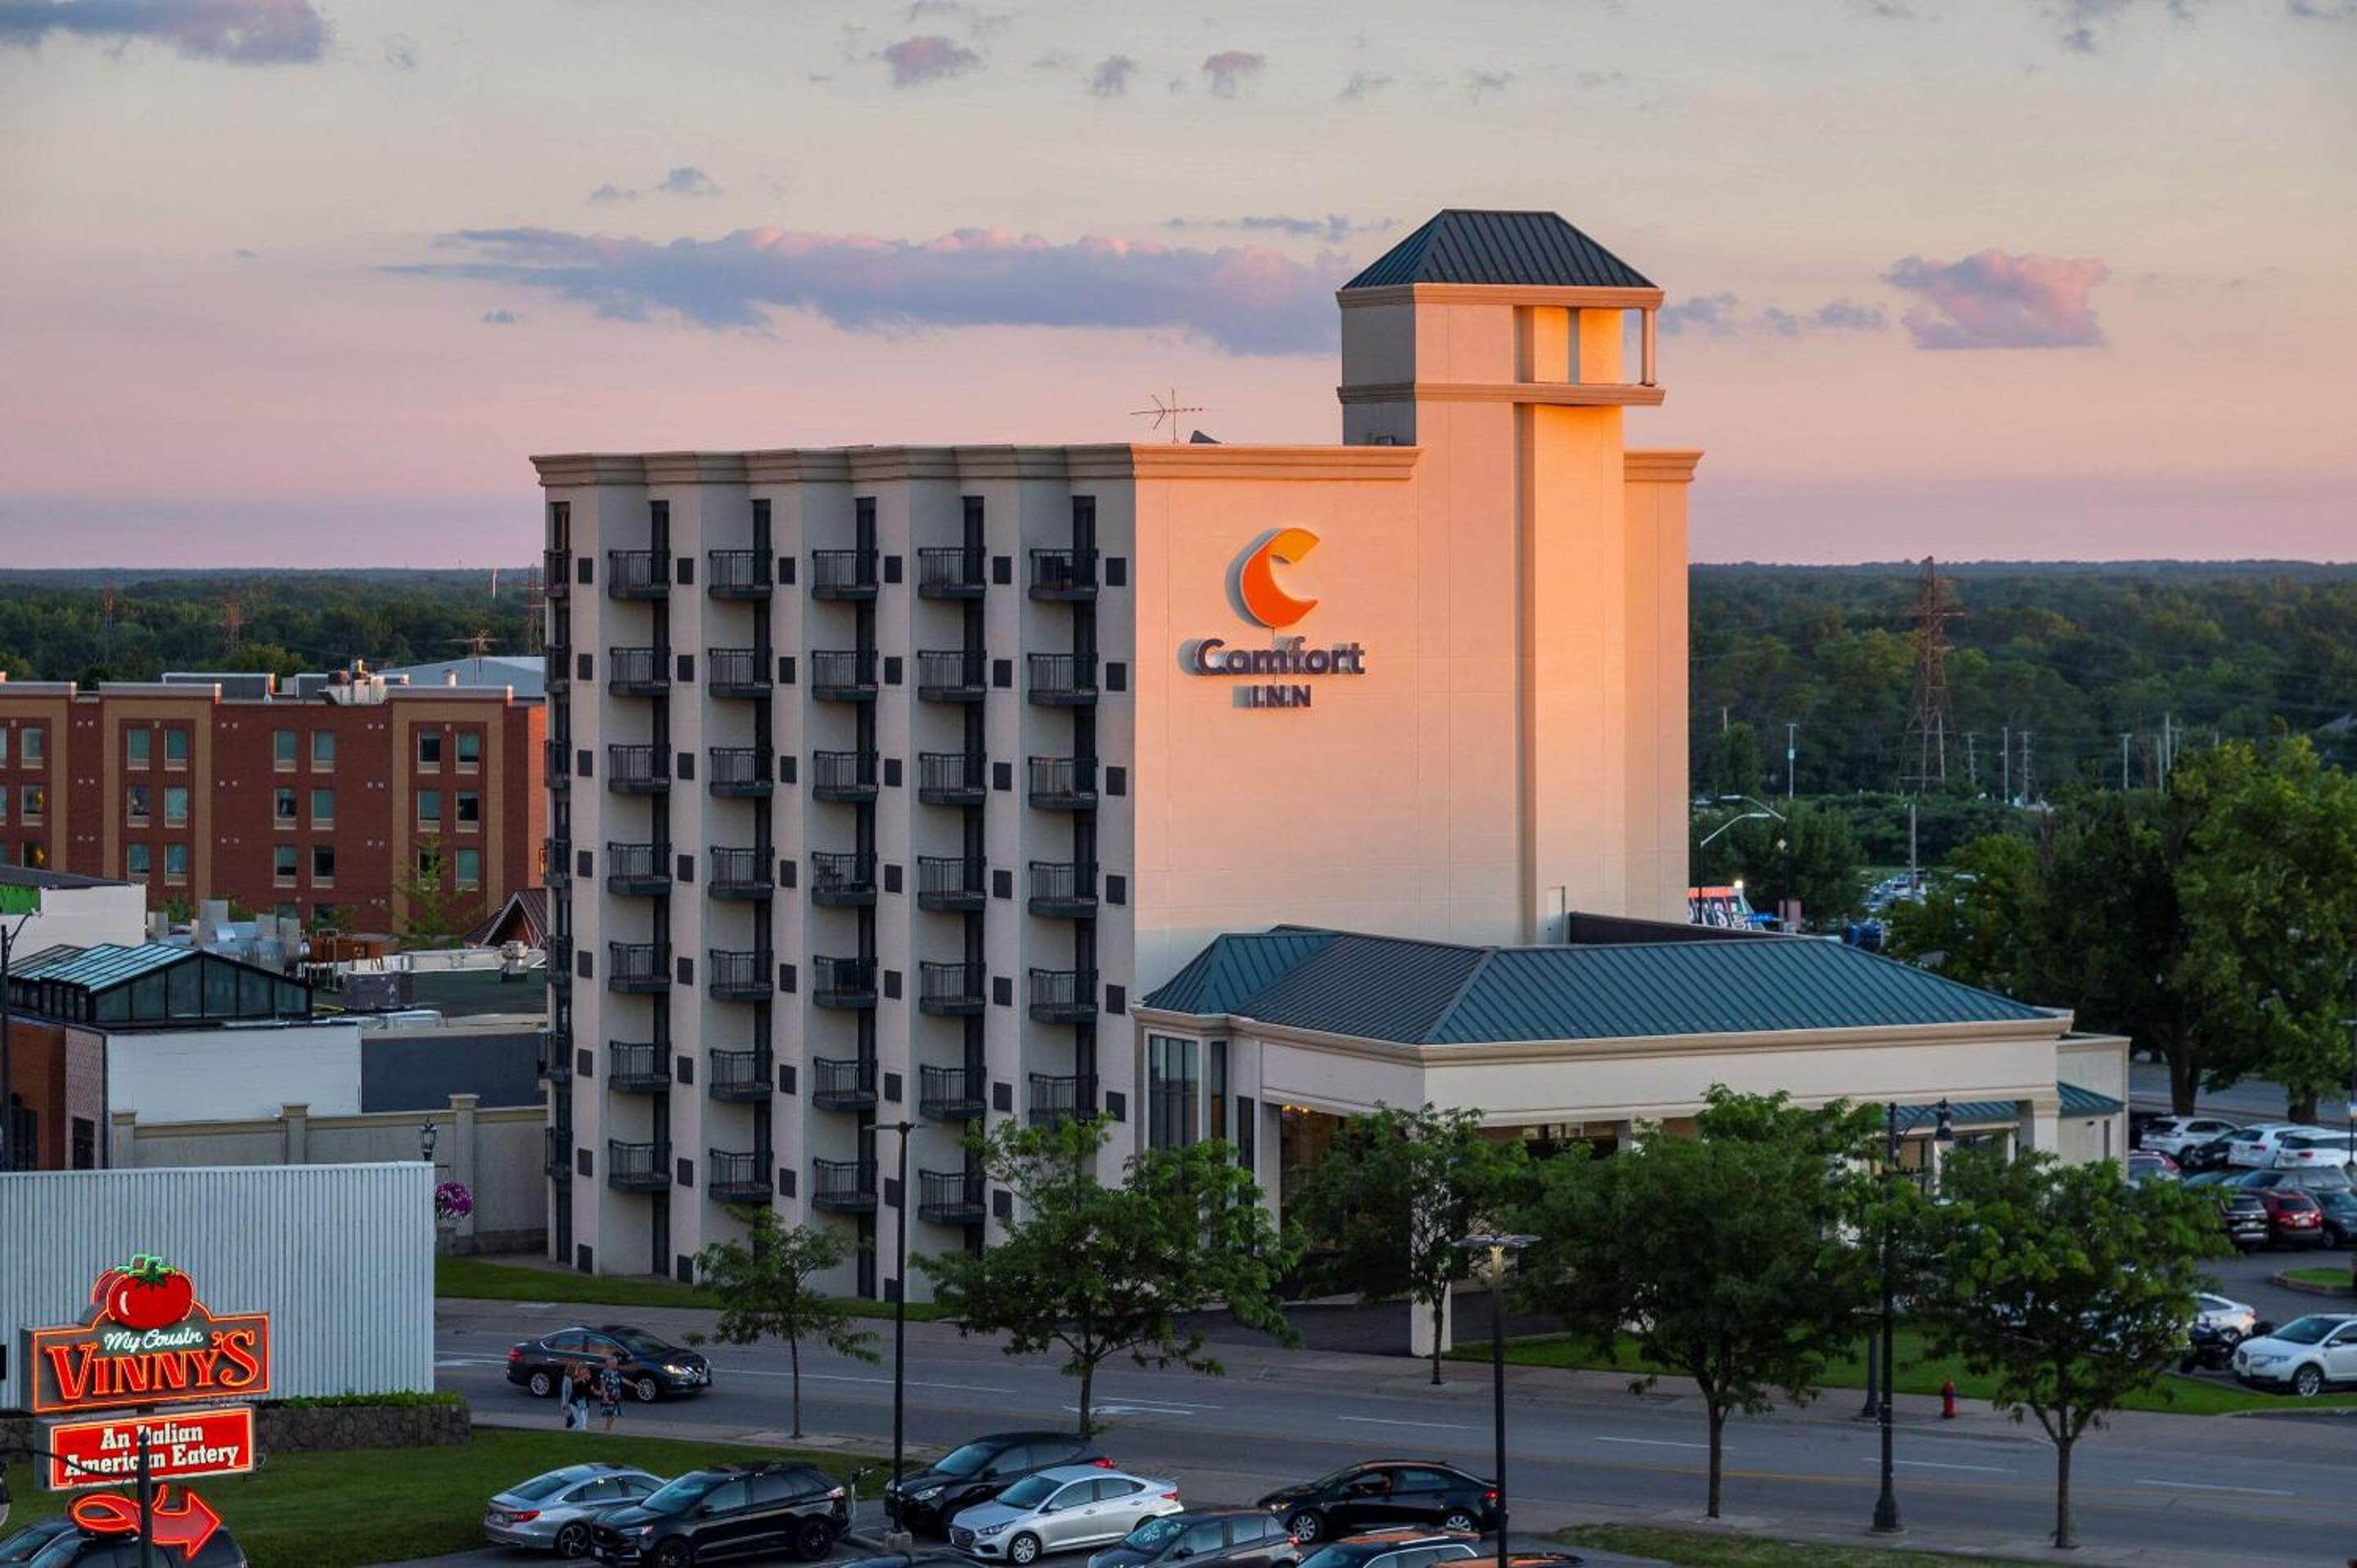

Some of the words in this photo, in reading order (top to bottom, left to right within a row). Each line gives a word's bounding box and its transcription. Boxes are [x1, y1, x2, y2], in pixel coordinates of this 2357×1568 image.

[1196, 636, 1366, 674] Comfort
[1251, 684, 1311, 707] INN
[104, 1331, 141, 1353] My
[142, 1327, 204, 1349] Cousin
[47, 1329, 259, 1399] VINNY'S
[100, 1427, 130, 1450] An
[65, 1451, 165, 1476] Americn
[172, 1444, 239, 1467] Eatery
